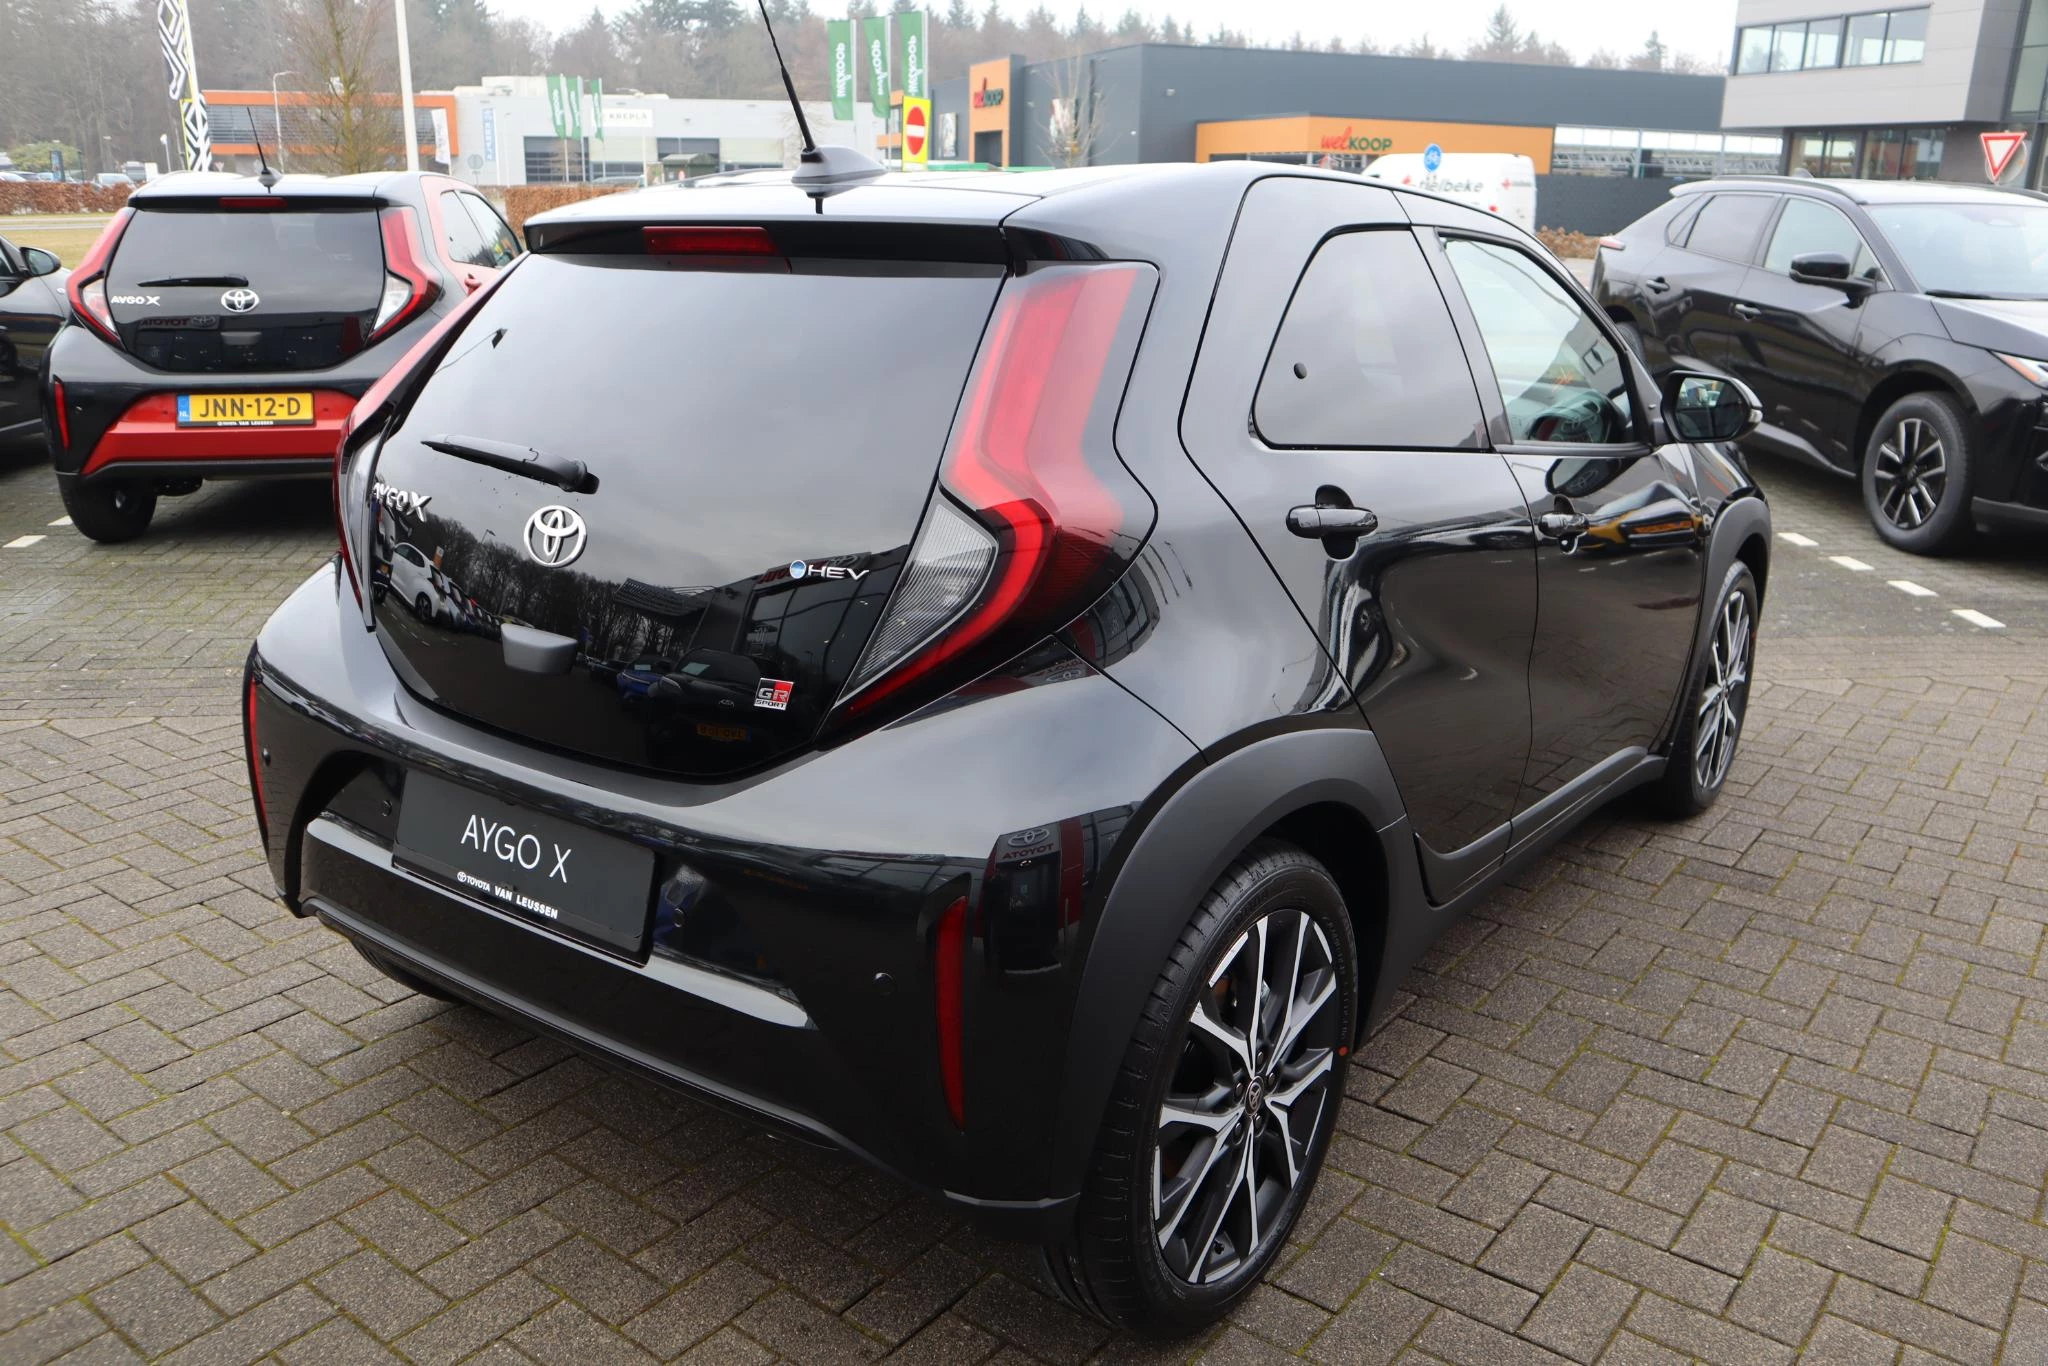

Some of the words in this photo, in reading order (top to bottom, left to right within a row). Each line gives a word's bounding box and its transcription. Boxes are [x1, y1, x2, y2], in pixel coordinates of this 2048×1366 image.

[111, 296, 145, 304] AYGO
[200, 397, 301, 417] JNN-12-D
[808, 564, 870, 580] HEV
[757, 687, 789, 702] GR
[755, 699, 785, 709] SPORT
[460, 814, 541, 869] AYGO
[549, 843, 572, 883] X
[466, 875, 491, 891] TOYOTA
[495, 885, 513, 901] VAN
[516, 894, 559, 919] LEUSSEN
